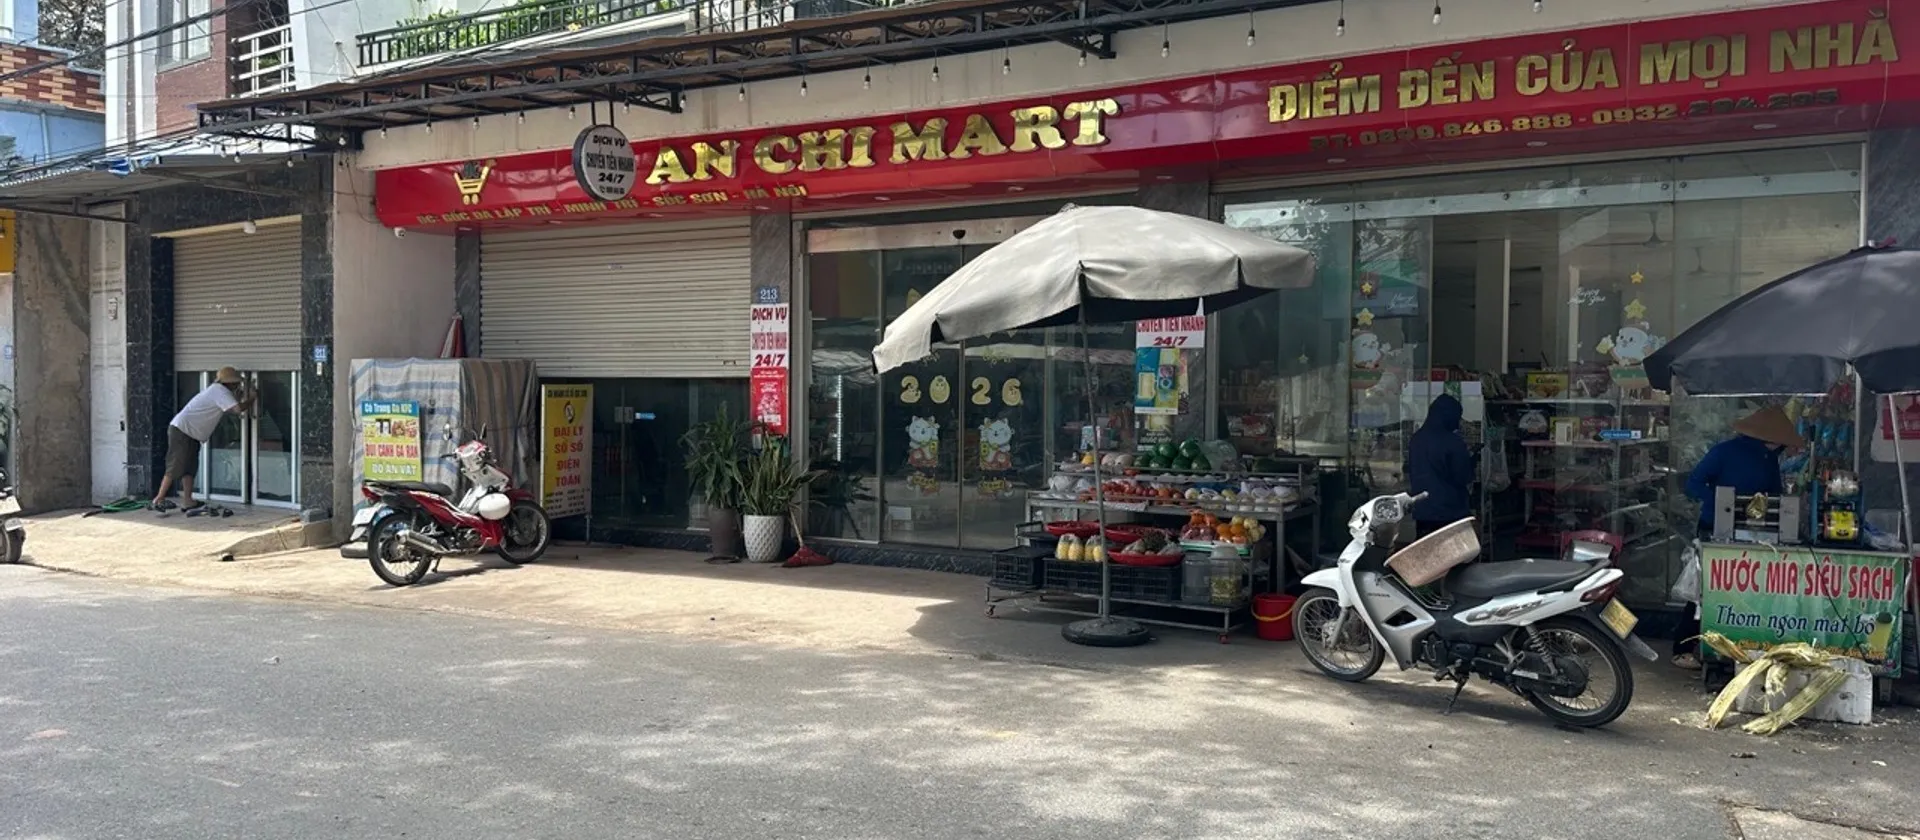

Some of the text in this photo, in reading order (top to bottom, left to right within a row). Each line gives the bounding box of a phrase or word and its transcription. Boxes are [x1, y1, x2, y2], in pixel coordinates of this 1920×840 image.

[1268, 9, 1898, 123] ĐIỂM ĐẾN CỦA MỌI NHÀ
[644, 98, 1120, 185] AN CHI MART
[598, 172, 625, 184] 24/7
[760, 288, 777, 300] 213
[752, 306, 788, 325] DỊCH VỤ
[1153, 335, 1188, 346] 24/7
[754, 353, 785, 367] 24/7
[1710, 551, 1894, 609] NƯỚC MÍA SIÊU SẠCH
[1768, 616, 1807, 637] ngon
